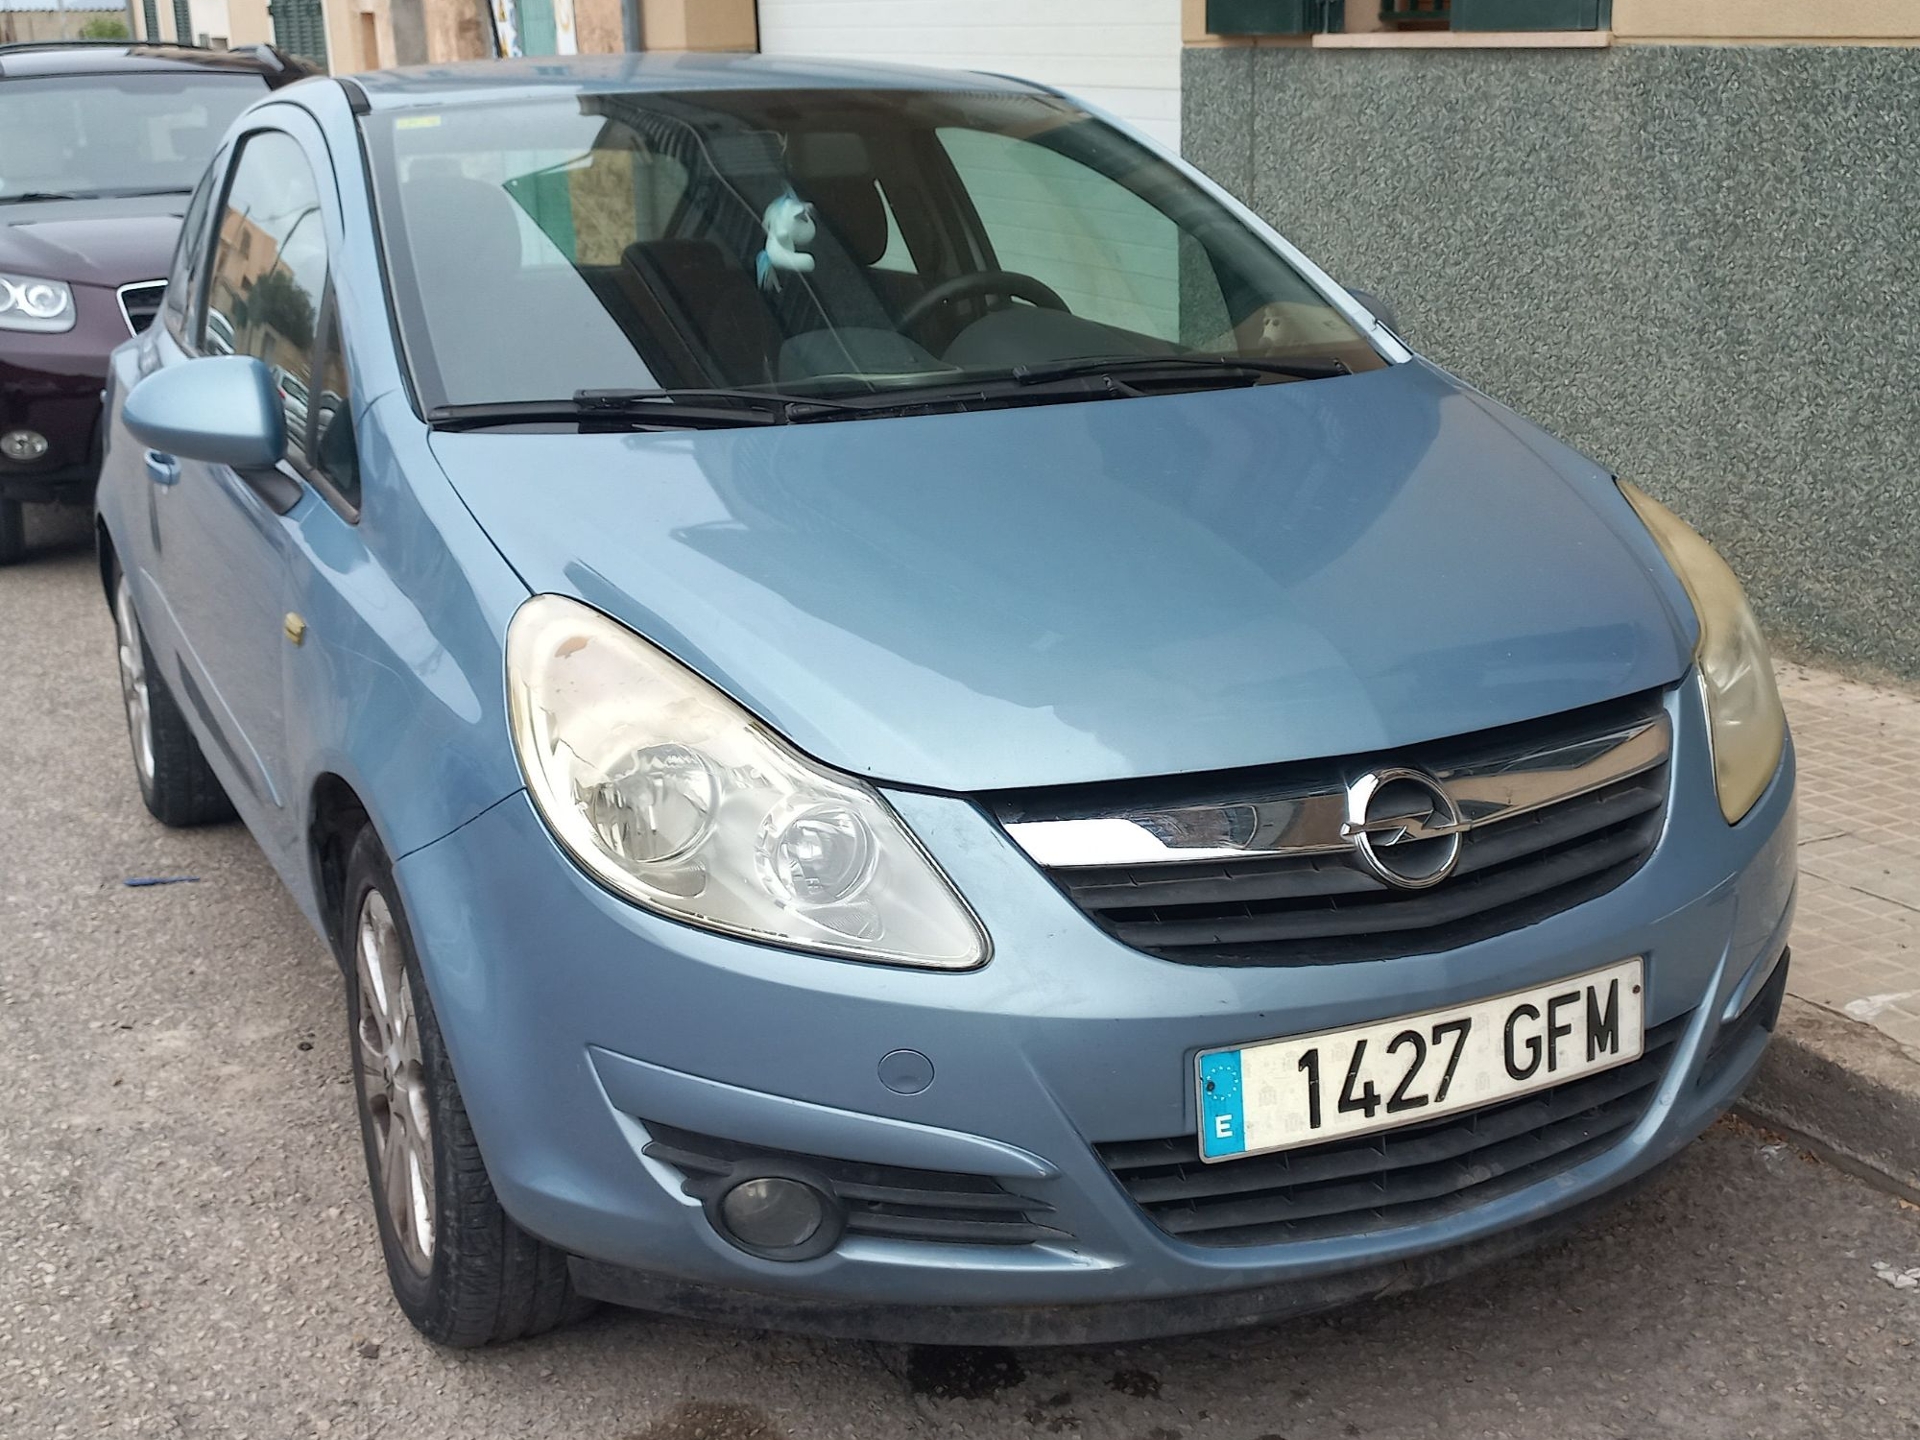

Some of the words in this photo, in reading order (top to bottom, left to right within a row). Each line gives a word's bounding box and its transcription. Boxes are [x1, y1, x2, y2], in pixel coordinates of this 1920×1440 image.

[1298, 1017, 1472, 1129] 1427
[1504, 978, 1619, 1081] GFM
[1215, 1114, 1233, 1138] E
